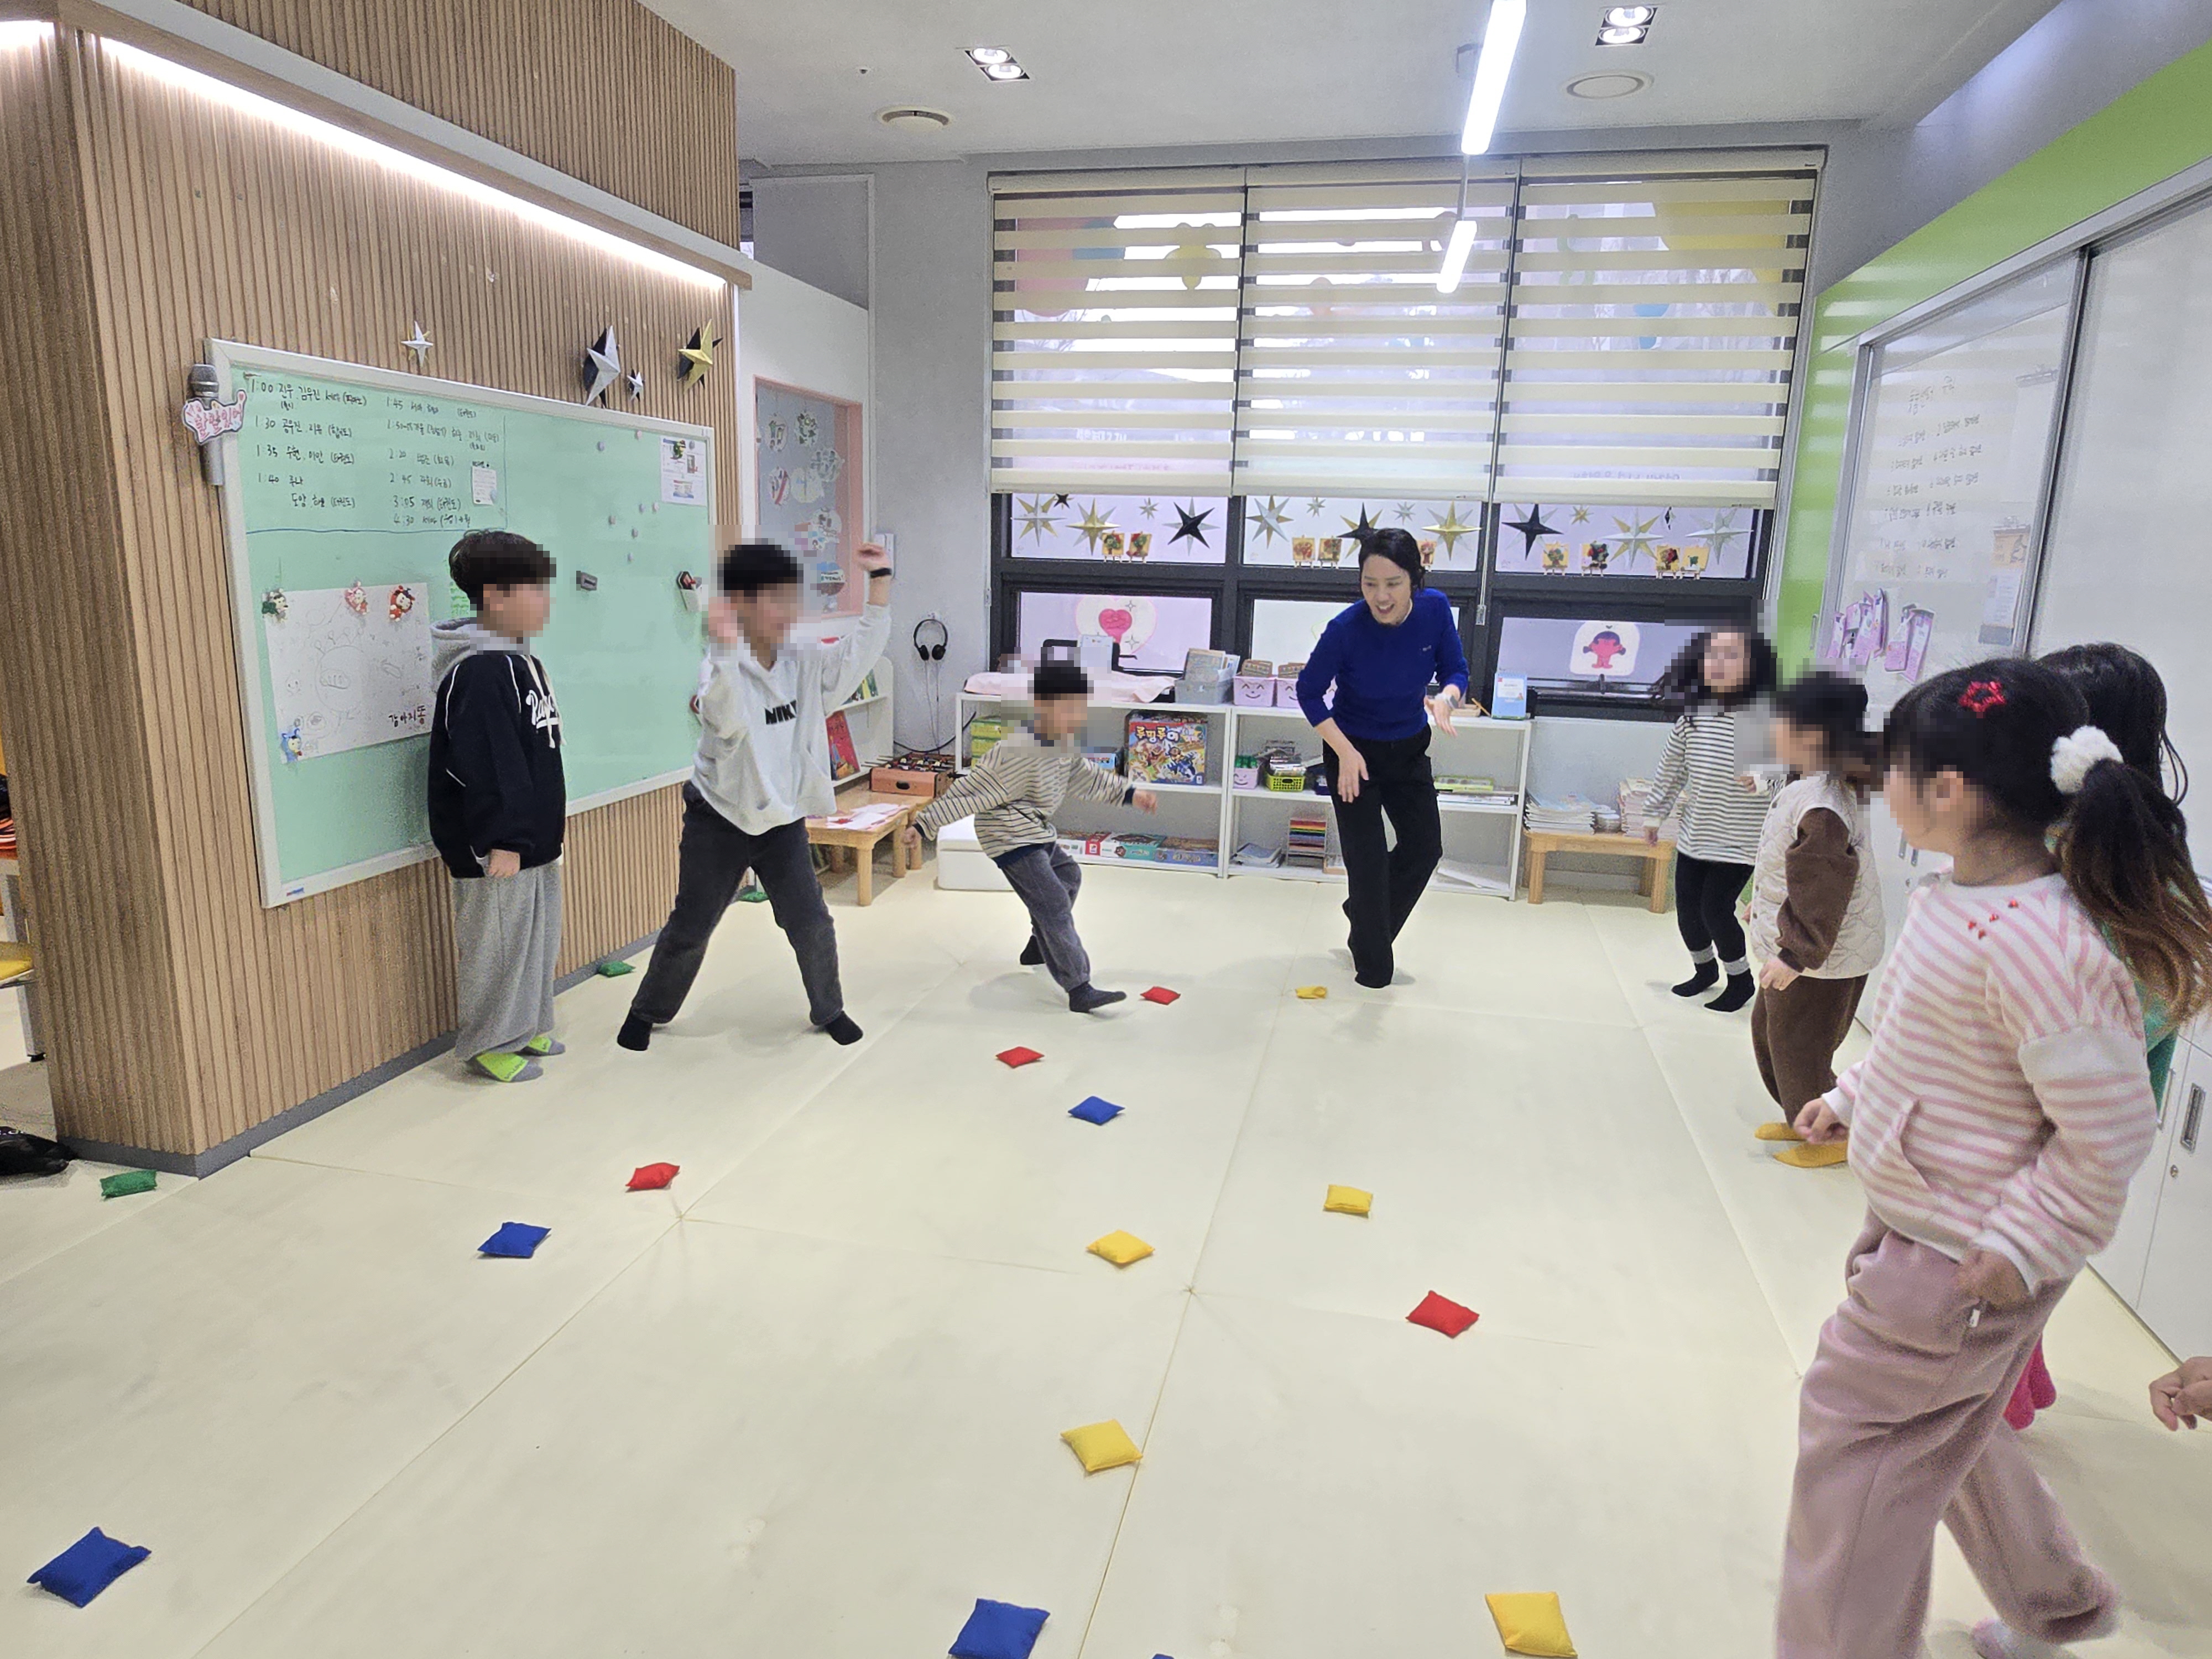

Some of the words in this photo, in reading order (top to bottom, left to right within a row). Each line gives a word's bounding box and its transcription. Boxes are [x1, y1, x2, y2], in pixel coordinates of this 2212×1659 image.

[252, 379, 274, 393] 1:00
[255, 415, 275, 430] 1:30
[257, 444, 278, 458] 1:35
[258, 472, 279, 484] 1:40
[393, 495, 415, 508] 3:05
[393, 513, 414, 526] 4:30
[388, 705, 426, 728] 강아지똥
